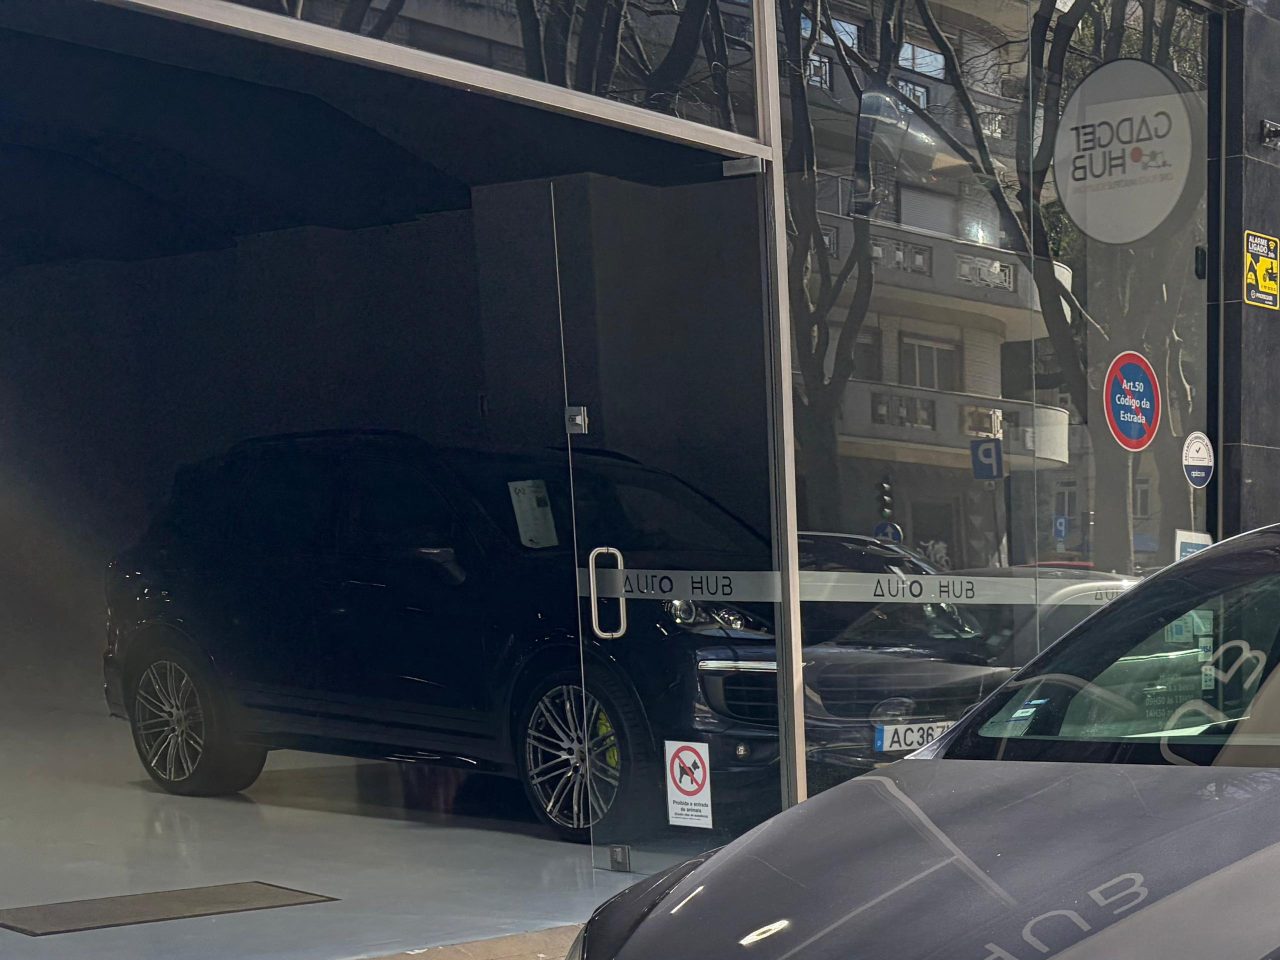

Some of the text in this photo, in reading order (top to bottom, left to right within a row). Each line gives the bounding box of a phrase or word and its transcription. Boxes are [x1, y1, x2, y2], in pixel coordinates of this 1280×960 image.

[1248, 235, 1268, 246] ALARME
[1248, 242, 1268, 253] LIGADO
[1121, 379, 1144, 393] Art.50
[1115, 394, 1150, 409] Código da
[1120, 410, 1146, 424] Estrada
[624, 575, 733, 596] AUTO HUB
[873, 578, 976, 599] AUTO HUB
